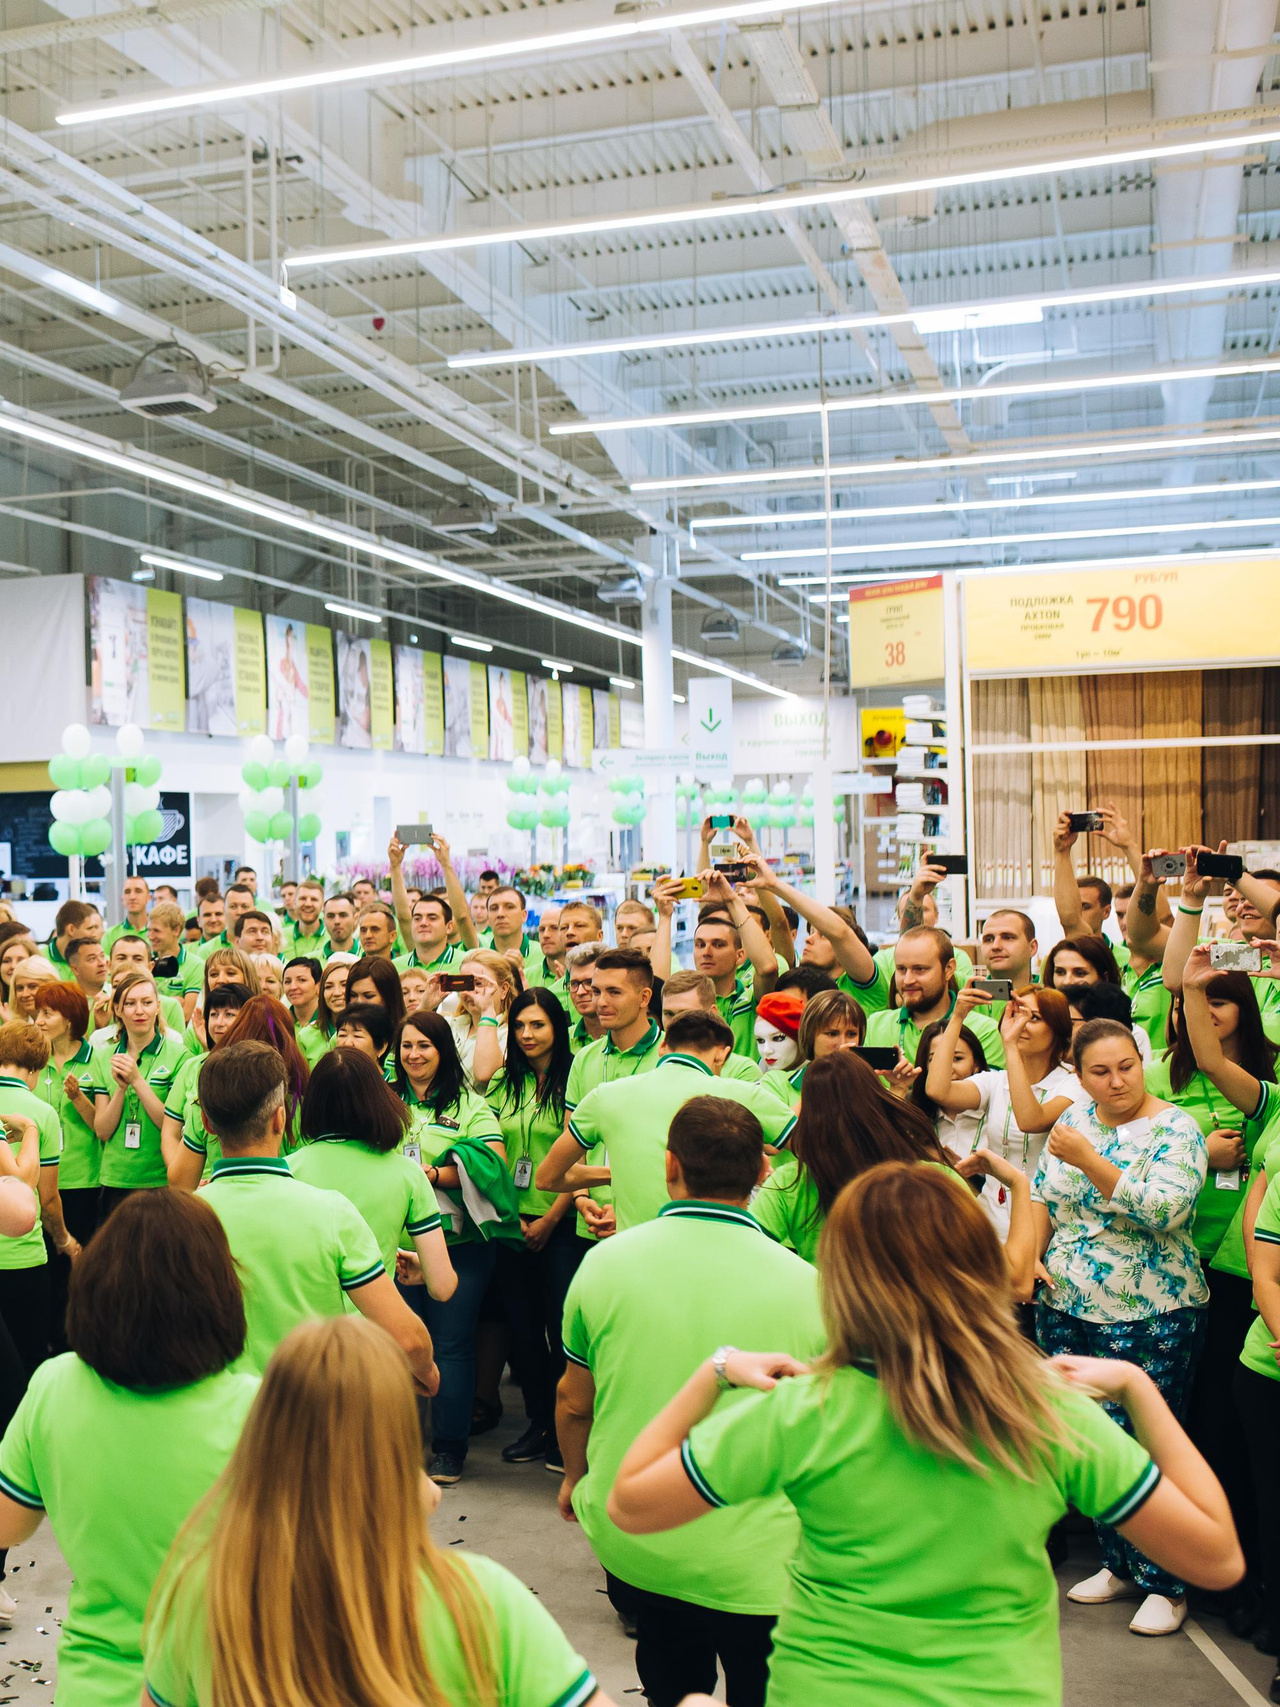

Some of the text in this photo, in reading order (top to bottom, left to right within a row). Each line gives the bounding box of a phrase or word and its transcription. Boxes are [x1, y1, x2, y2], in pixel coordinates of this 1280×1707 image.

[1010, 595, 1074, 608] ПОДЛОЖКА
[1024, 610, 1061, 621] AXTON
[1086, 594, 1163, 632] 790
[885, 642, 906, 668] 38
[135, 844, 188, 866] КАФЕ
